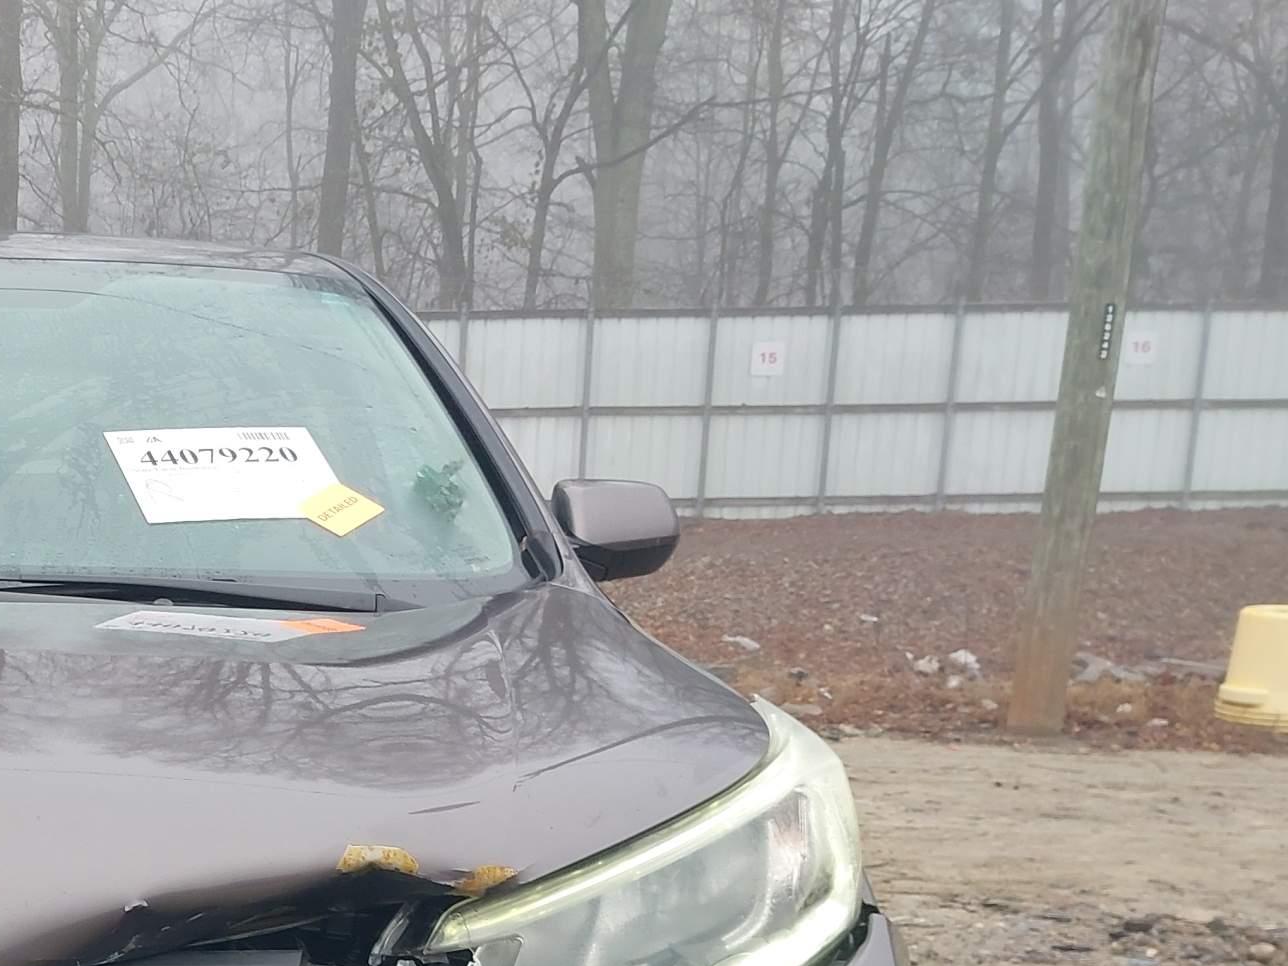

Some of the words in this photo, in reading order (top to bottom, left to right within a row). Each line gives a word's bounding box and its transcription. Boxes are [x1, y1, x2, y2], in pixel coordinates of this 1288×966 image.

[759, 351, 778, 365] 15
[140, 446, 298, 466] 44079220
[317, 496, 359, 522] DETAILED
